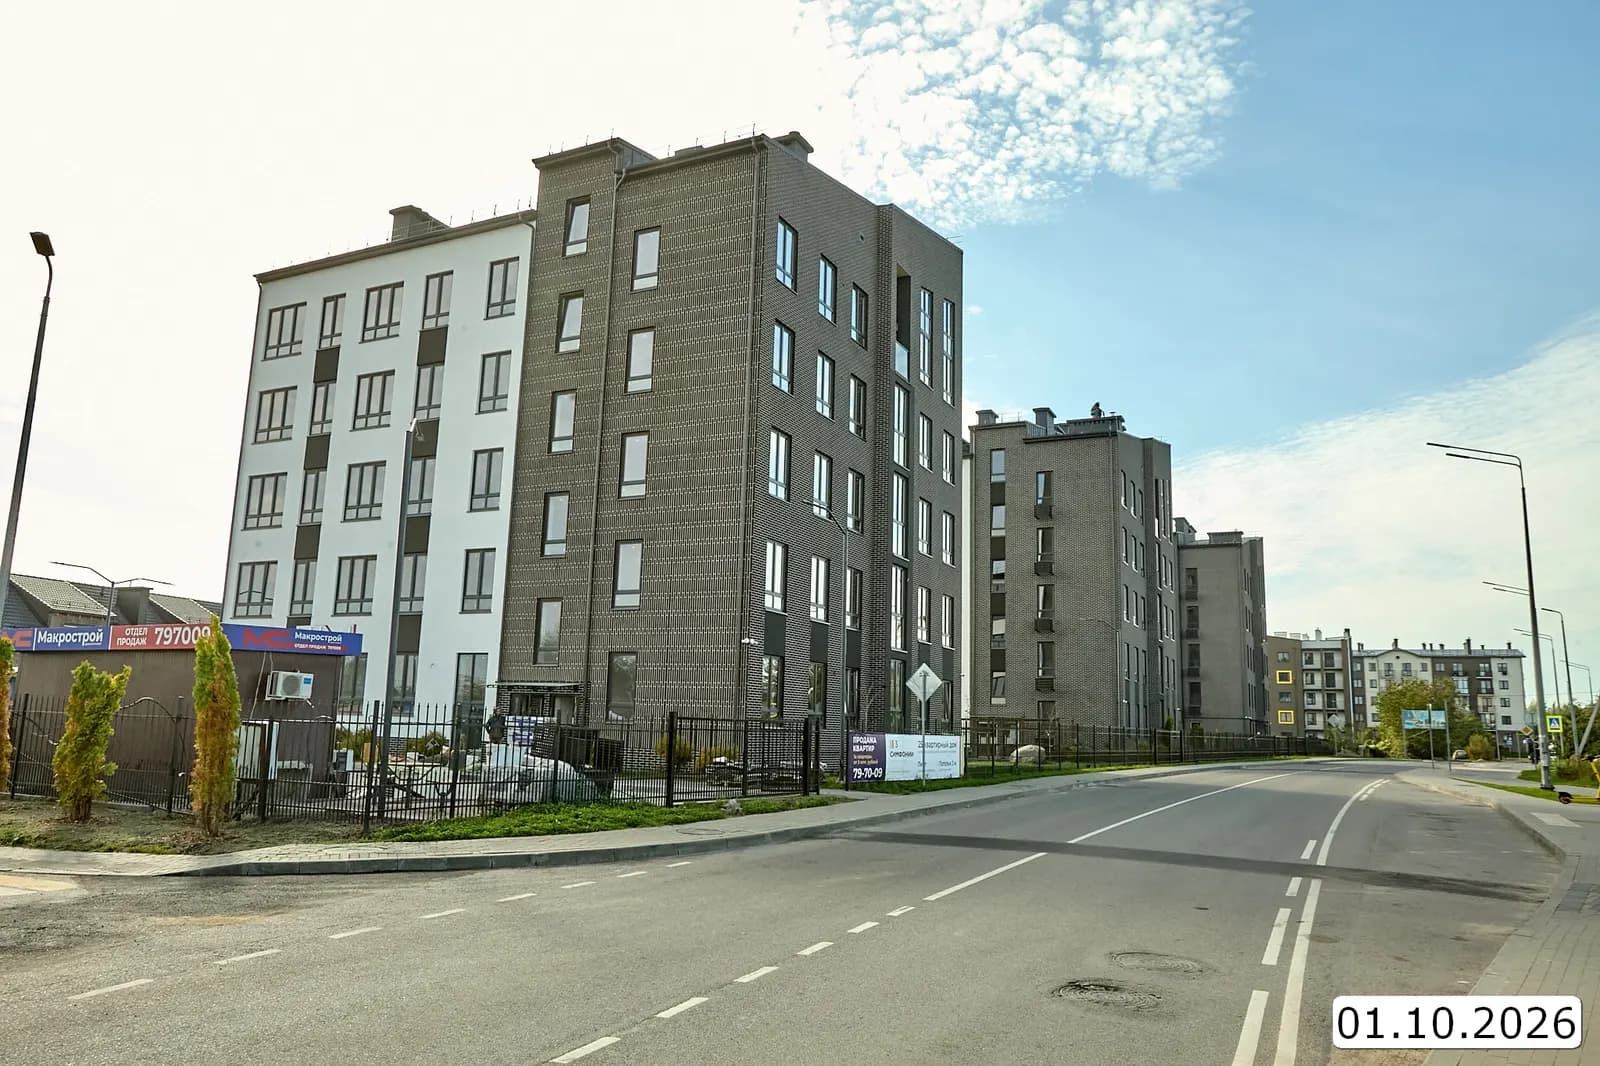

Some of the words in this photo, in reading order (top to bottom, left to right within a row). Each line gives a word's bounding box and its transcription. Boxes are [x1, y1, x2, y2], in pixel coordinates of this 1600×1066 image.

[37, 628, 103, 647] Макрострой
[124, 627, 148, 637] ОТДЕЛ
[294, 631, 343, 644] Макрострой
[116, 637, 147, 647] ПРОДАЖ
[852, 736, 877, 744] ПРОДАЖА
[852, 767, 883, 779] 79-70-09
